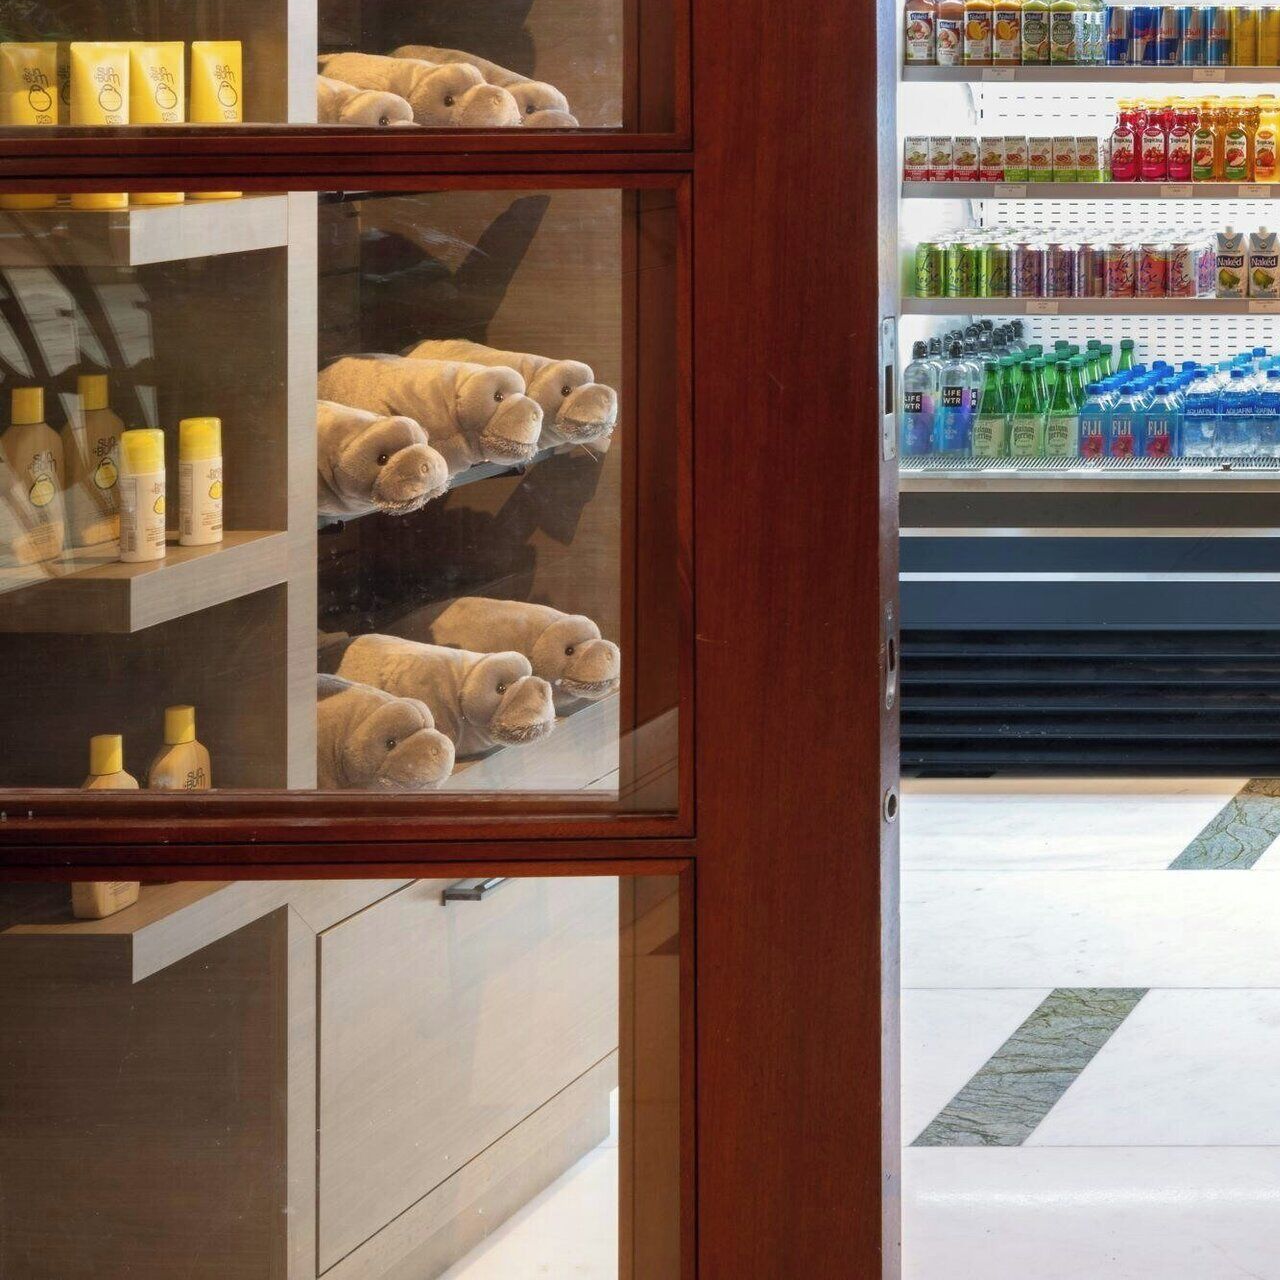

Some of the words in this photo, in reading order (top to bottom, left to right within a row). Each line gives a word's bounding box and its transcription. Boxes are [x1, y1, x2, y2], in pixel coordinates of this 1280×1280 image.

[1216, 255, 1242, 266] Naked
[1251, 255, 1276, 266] Naked
[943, 397, 961, 405] WTR
[1082, 420, 1101, 436] FIJI
[1112, 420, 1131, 435] FIJI
[1148, 420, 1167, 436] FIJI
